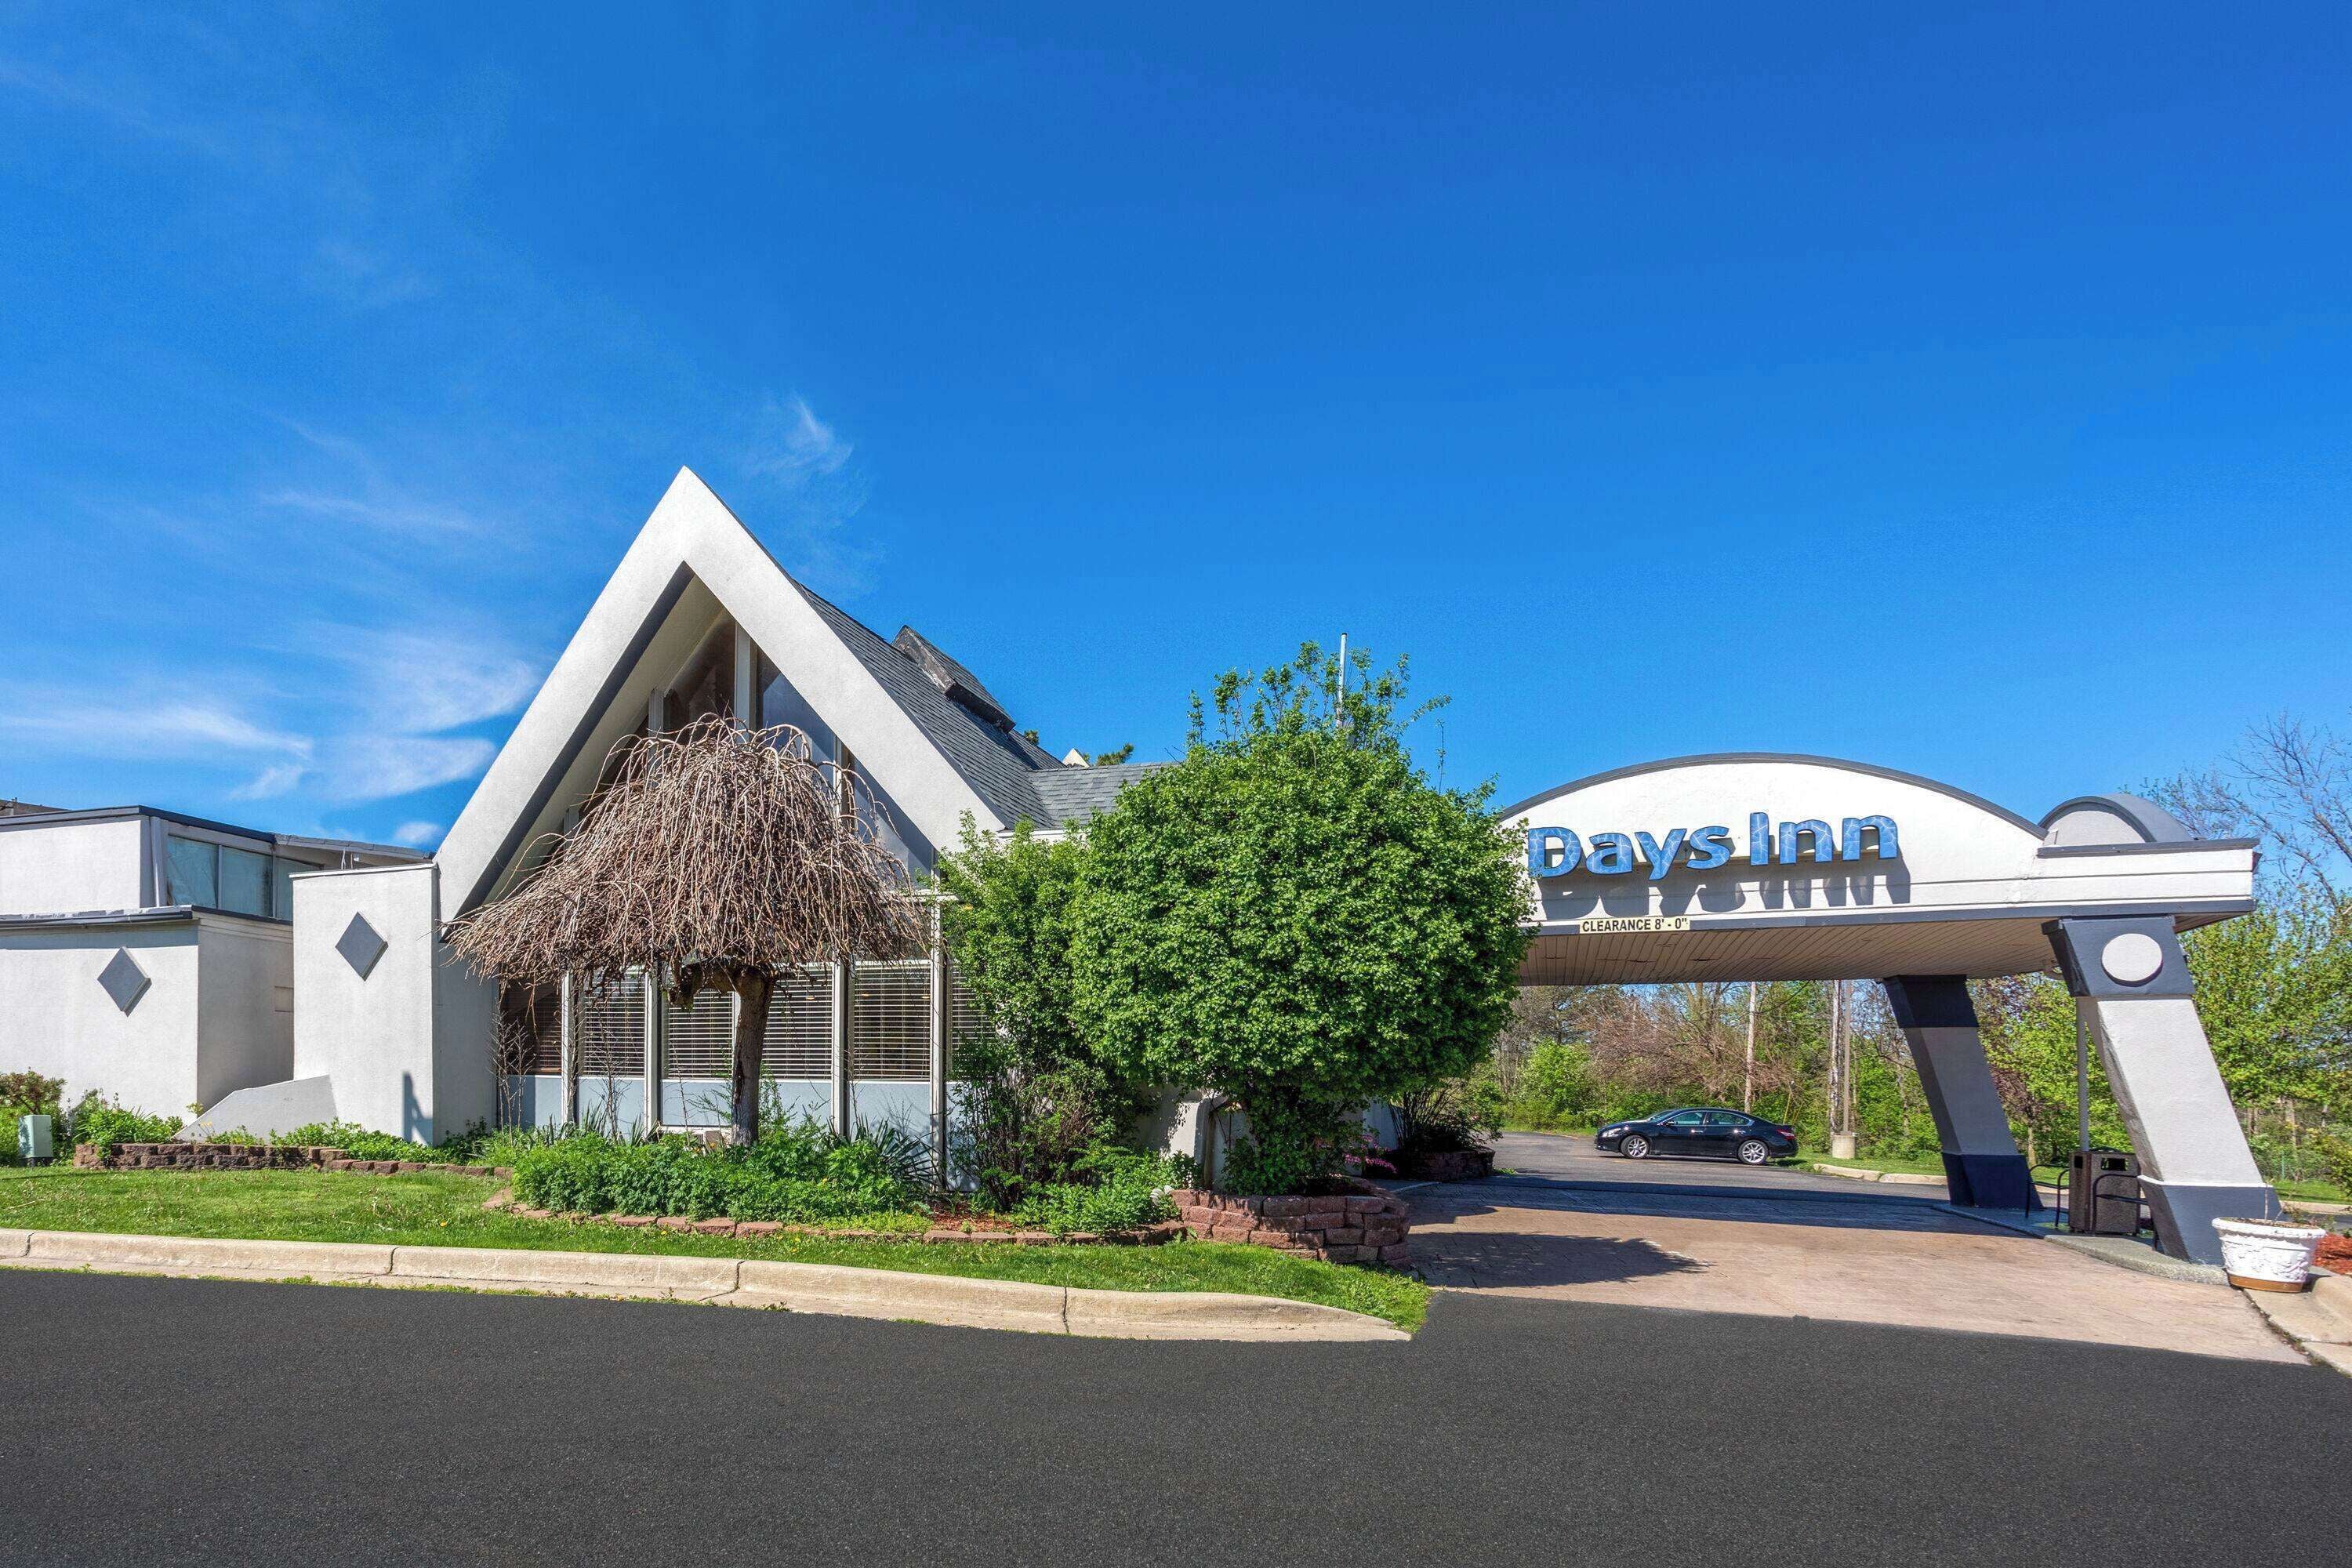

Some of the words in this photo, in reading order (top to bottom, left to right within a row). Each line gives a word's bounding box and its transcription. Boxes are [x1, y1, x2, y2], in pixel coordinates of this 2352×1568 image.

[1527, 826, 1730, 881] Days
[1749, 811, 1899, 866] Inn
[1582, 919, 1651, 932] CLEARANCE
[1654, 918, 1664, 931] 8'
